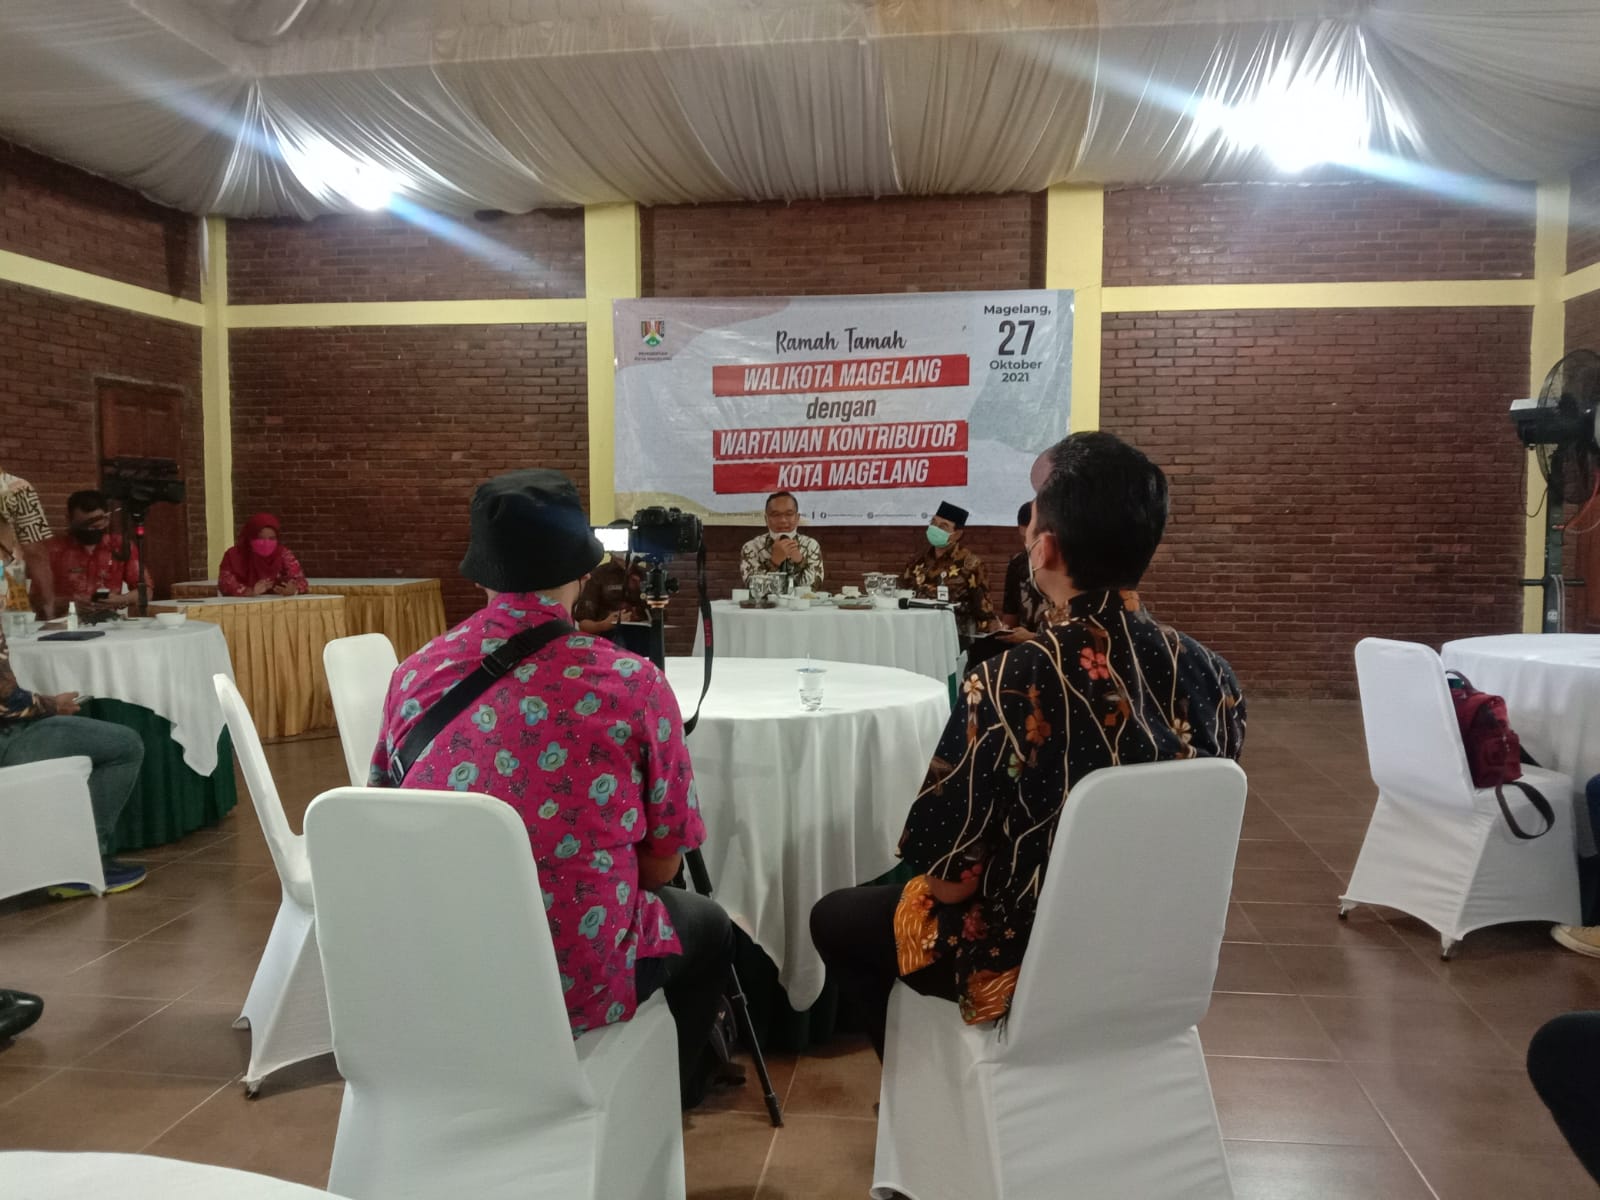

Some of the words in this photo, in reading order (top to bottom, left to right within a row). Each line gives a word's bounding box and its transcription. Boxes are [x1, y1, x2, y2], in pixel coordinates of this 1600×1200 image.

[983, 304, 1052, 317] Magelang,
[776, 330, 839, 354] Ramah
[845, 327, 907, 353] Tamah
[998, 320, 1036, 356] 27
[743, 363, 834, 392] WALIKOTA
[839, 358, 942, 388] MAGELANG
[989, 360, 1042, 370] Oktober
[1001, 372, 1030, 383] 2021
[806, 397, 877, 423] dengan
[720, 430, 822, 456] WARTAWAN
[827, 423, 958, 452] KONTRIBUTOR
[777, 463, 823, 488] KOTA
[828, 459, 930, 486] MAGELANG
